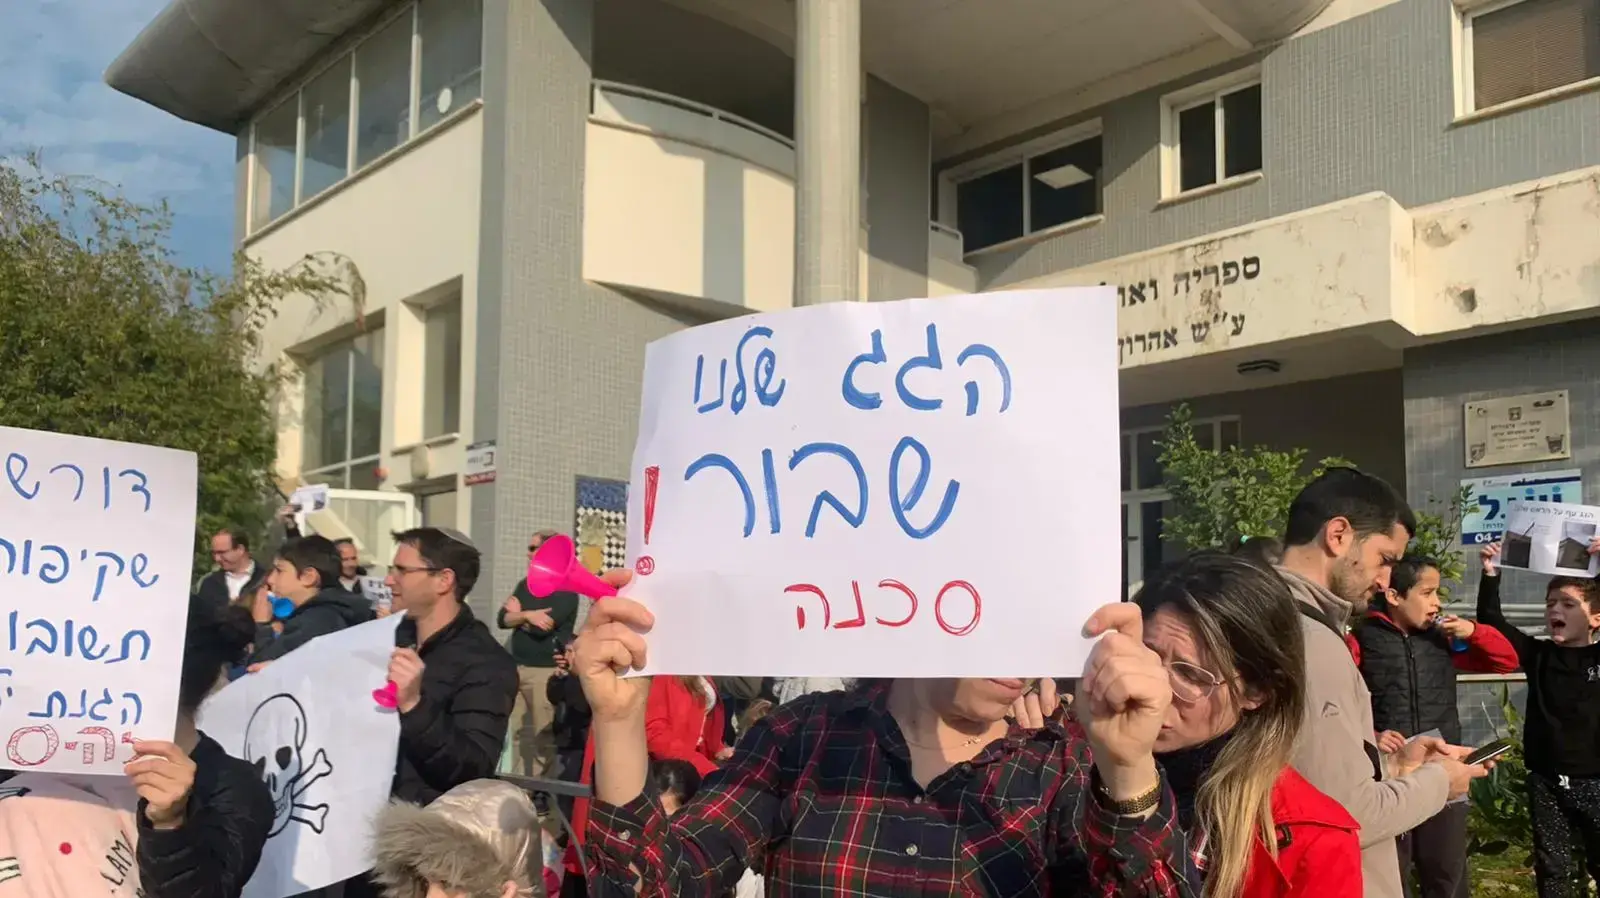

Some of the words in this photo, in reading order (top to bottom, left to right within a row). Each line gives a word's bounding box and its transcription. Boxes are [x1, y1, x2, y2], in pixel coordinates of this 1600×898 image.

[1173, 255, 1260, 296] ספריה
[693, 325, 786, 415] שלנו
[842, 323, 1011, 416] הגג
[6, 452, 151, 513] דורש
[684, 436, 960, 540] שבור
[784, 579, 982, 637] סכנה
[28, 687, 143, 725] הגנת
